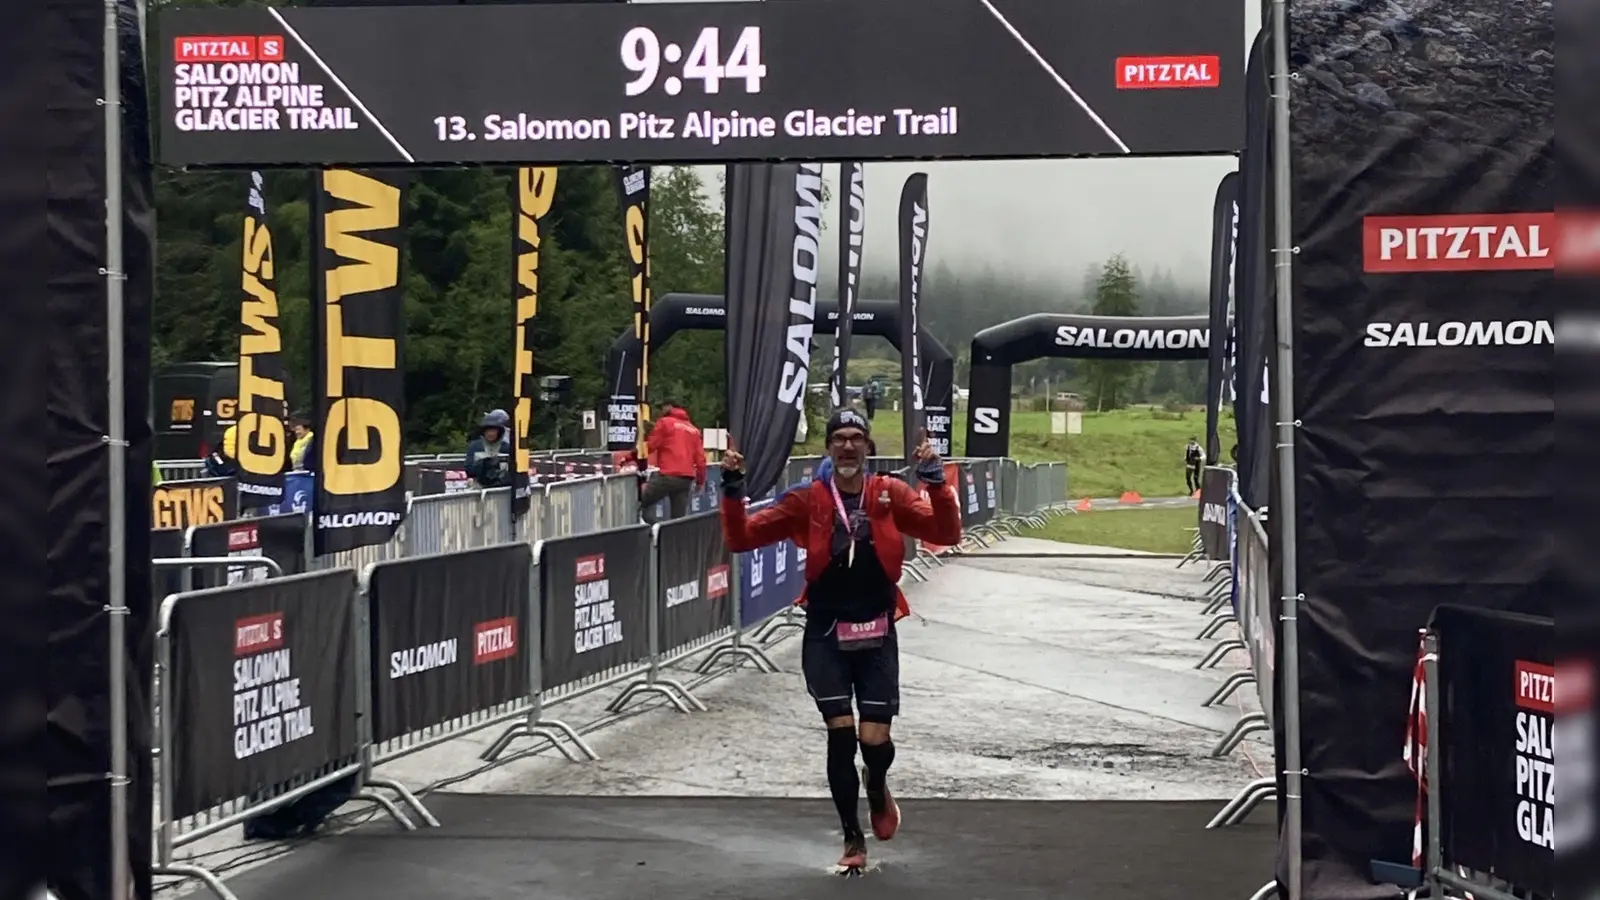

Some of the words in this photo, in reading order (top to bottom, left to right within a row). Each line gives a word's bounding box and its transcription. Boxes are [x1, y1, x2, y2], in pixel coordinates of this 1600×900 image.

[182, 42, 250, 56] PITZTAL
[264, 41, 278, 55] S
[620, 26, 766, 97] 9:44
[175, 63, 299, 85] SALOMON
[1124, 62, 1212, 82] PITZTAL
[175, 86, 229, 108] PITZ
[236, 85, 324, 107] ALPINE
[175, 108, 281, 131] GLACIER
[286, 107, 358, 130] TRAIL
[434, 116, 476, 141] 13.
[484, 113, 611, 140] Salomon
[620, 111, 675, 139] Pitz
[682, 110, 775, 145] Alpine
[784, 109, 886, 137] Glacier
[893, 107, 957, 135] Trail
[1380, 225, 1550, 260] PITZTAL
[778, 163, 821, 411] SALOM
[685, 307, 725, 316] SALOMO
[237, 216, 285, 475] GTWS
[1055, 325, 1210, 349] SALOMON
[1363, 321, 1554, 347] SALOMON
[974, 408, 999, 434] S
[153, 487, 224, 530] GTWS
[234, 648, 290, 692] SALOMON
[389, 638, 458, 679] SALOMON
[477, 625, 515, 656] PITZTAL
[234, 688, 260, 726] PITZ
[261, 678, 301, 717] ALPINE
[235, 716, 283, 759] GLACIER
[284, 705, 314, 743] TRAIL
[1516, 712, 1554, 759] SAL
